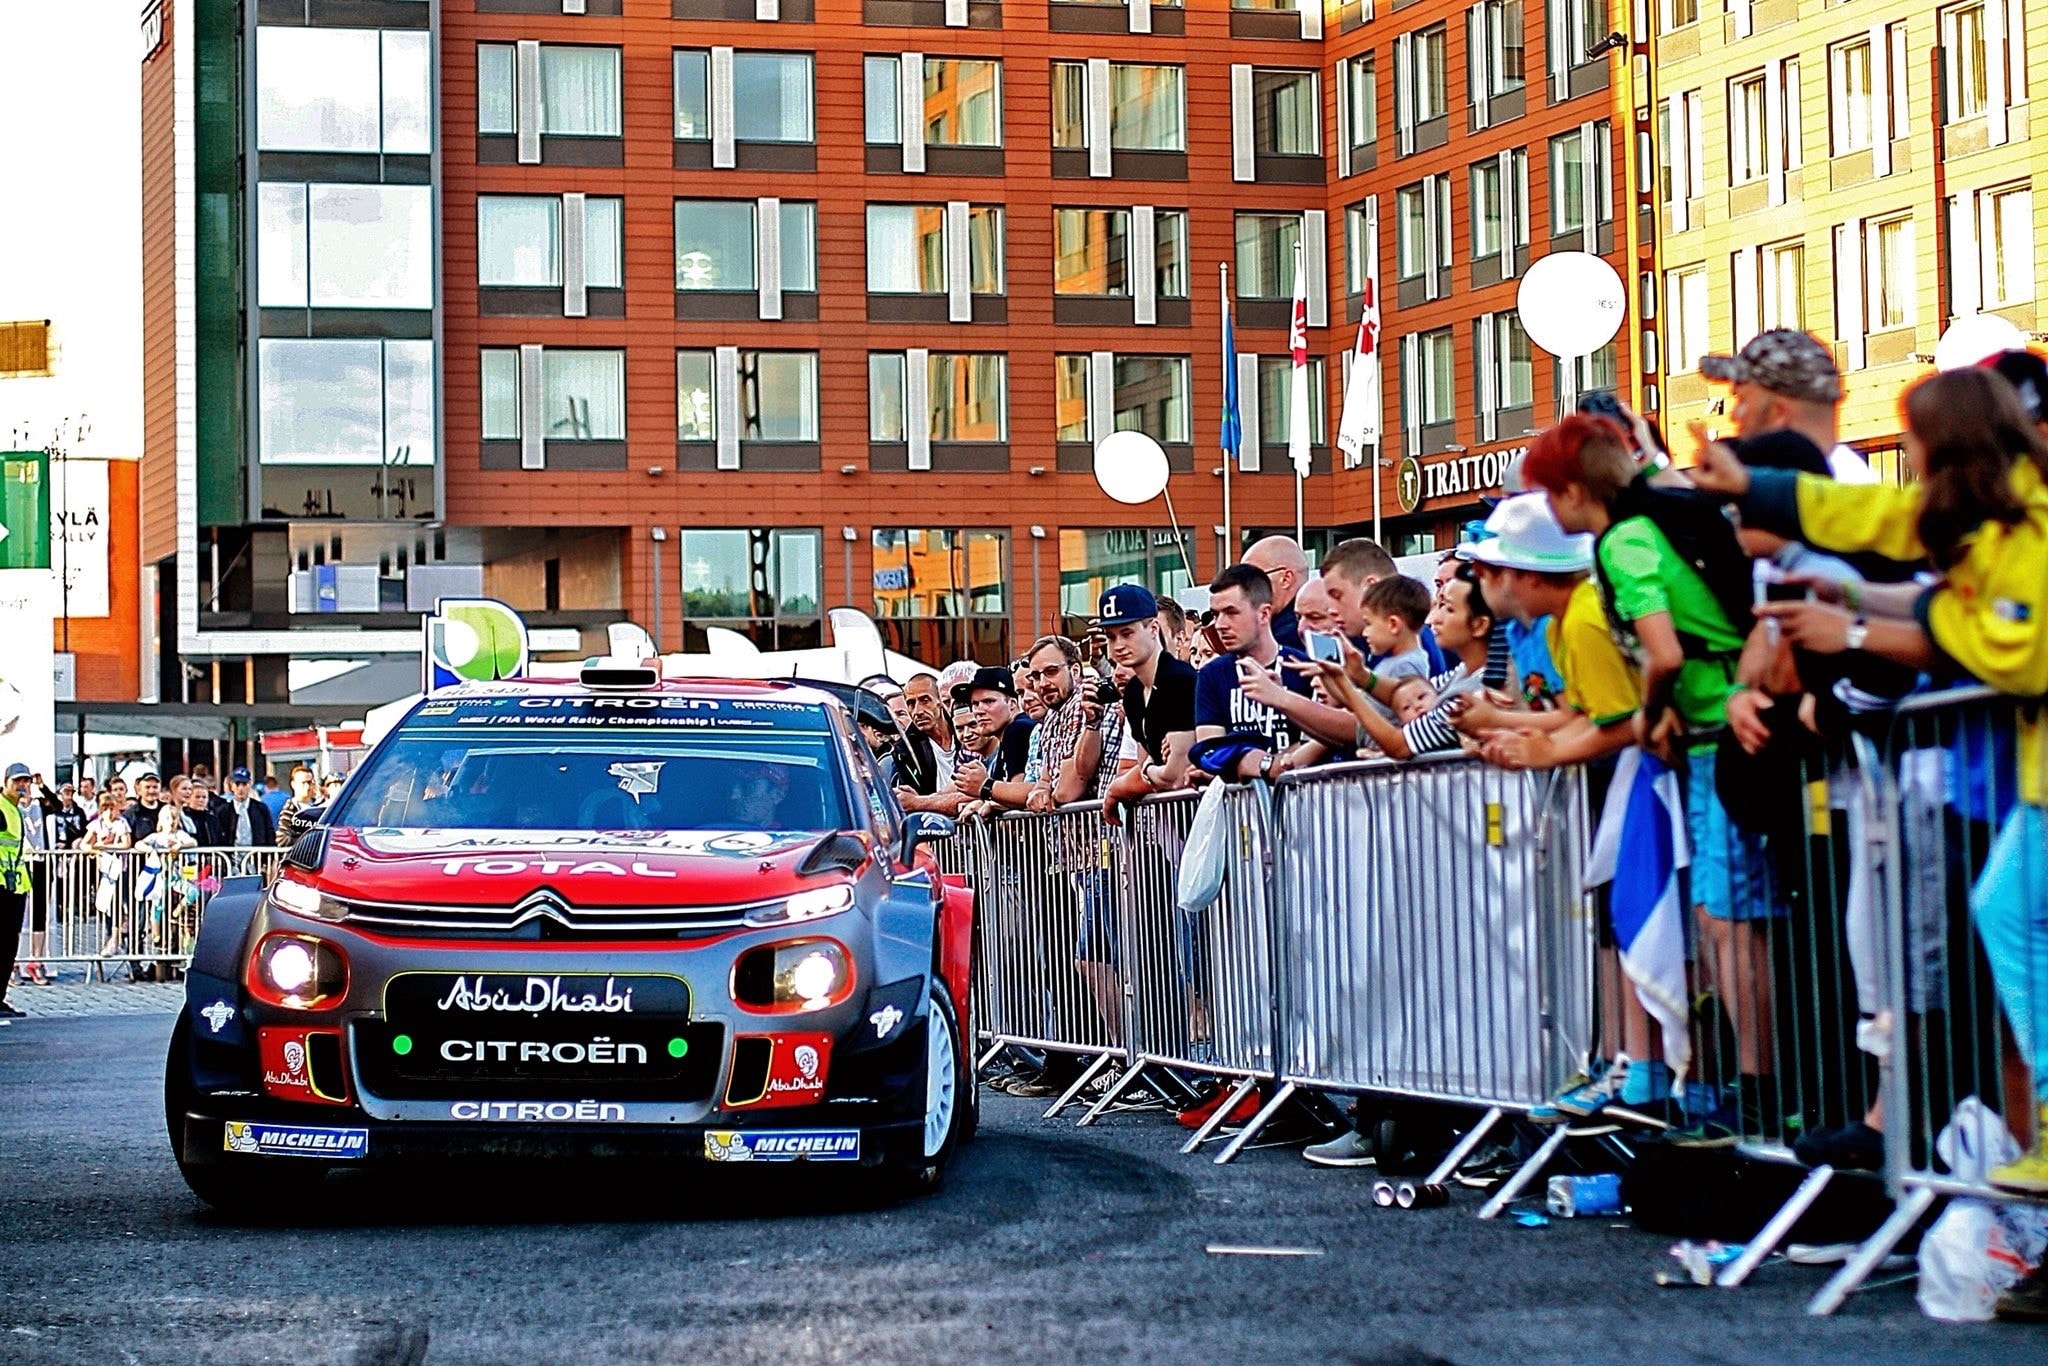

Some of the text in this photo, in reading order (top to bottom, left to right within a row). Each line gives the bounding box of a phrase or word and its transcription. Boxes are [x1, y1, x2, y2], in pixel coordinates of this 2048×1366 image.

[57, 507, 98, 525] YLÄ
[518, 697, 720, 710] CITROËN
[524, 715, 566, 725] World
[568, 715, 604, 726] Rally
[608, 716, 709, 727] Championship
[431, 858, 677, 877] TOTAL
[440, 1036, 647, 1063] CITROËN
[451, 1099, 625, 1121] CITROËN
[260, 1132, 364, 1148] MICHELIN
[755, 1137, 857, 1152] MICHELIN
